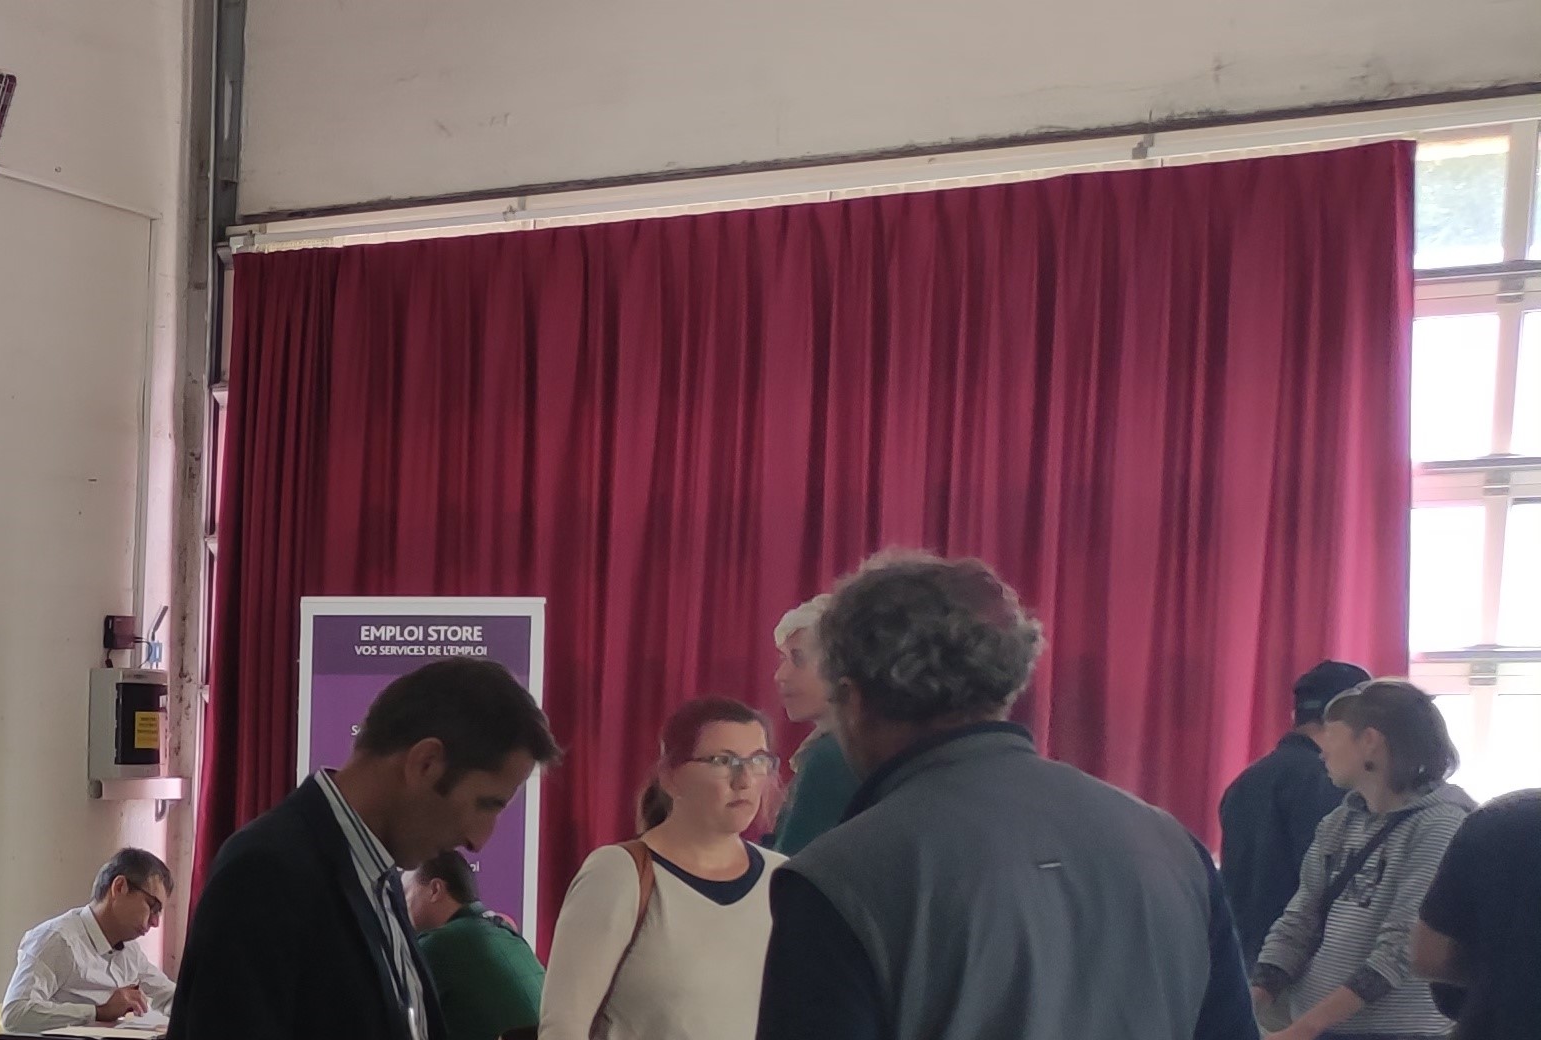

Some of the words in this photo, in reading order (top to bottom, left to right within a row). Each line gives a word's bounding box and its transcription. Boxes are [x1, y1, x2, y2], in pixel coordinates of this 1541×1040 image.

[360, 625, 424, 642] EMPLOI
[427, 625, 483, 642] STORE
[354, 645, 377, 656] VOS
[379, 645, 425, 656] SERVICES
[428, 645, 442, 656] DE
[443, 645, 488, 657] L'EMPLOI
